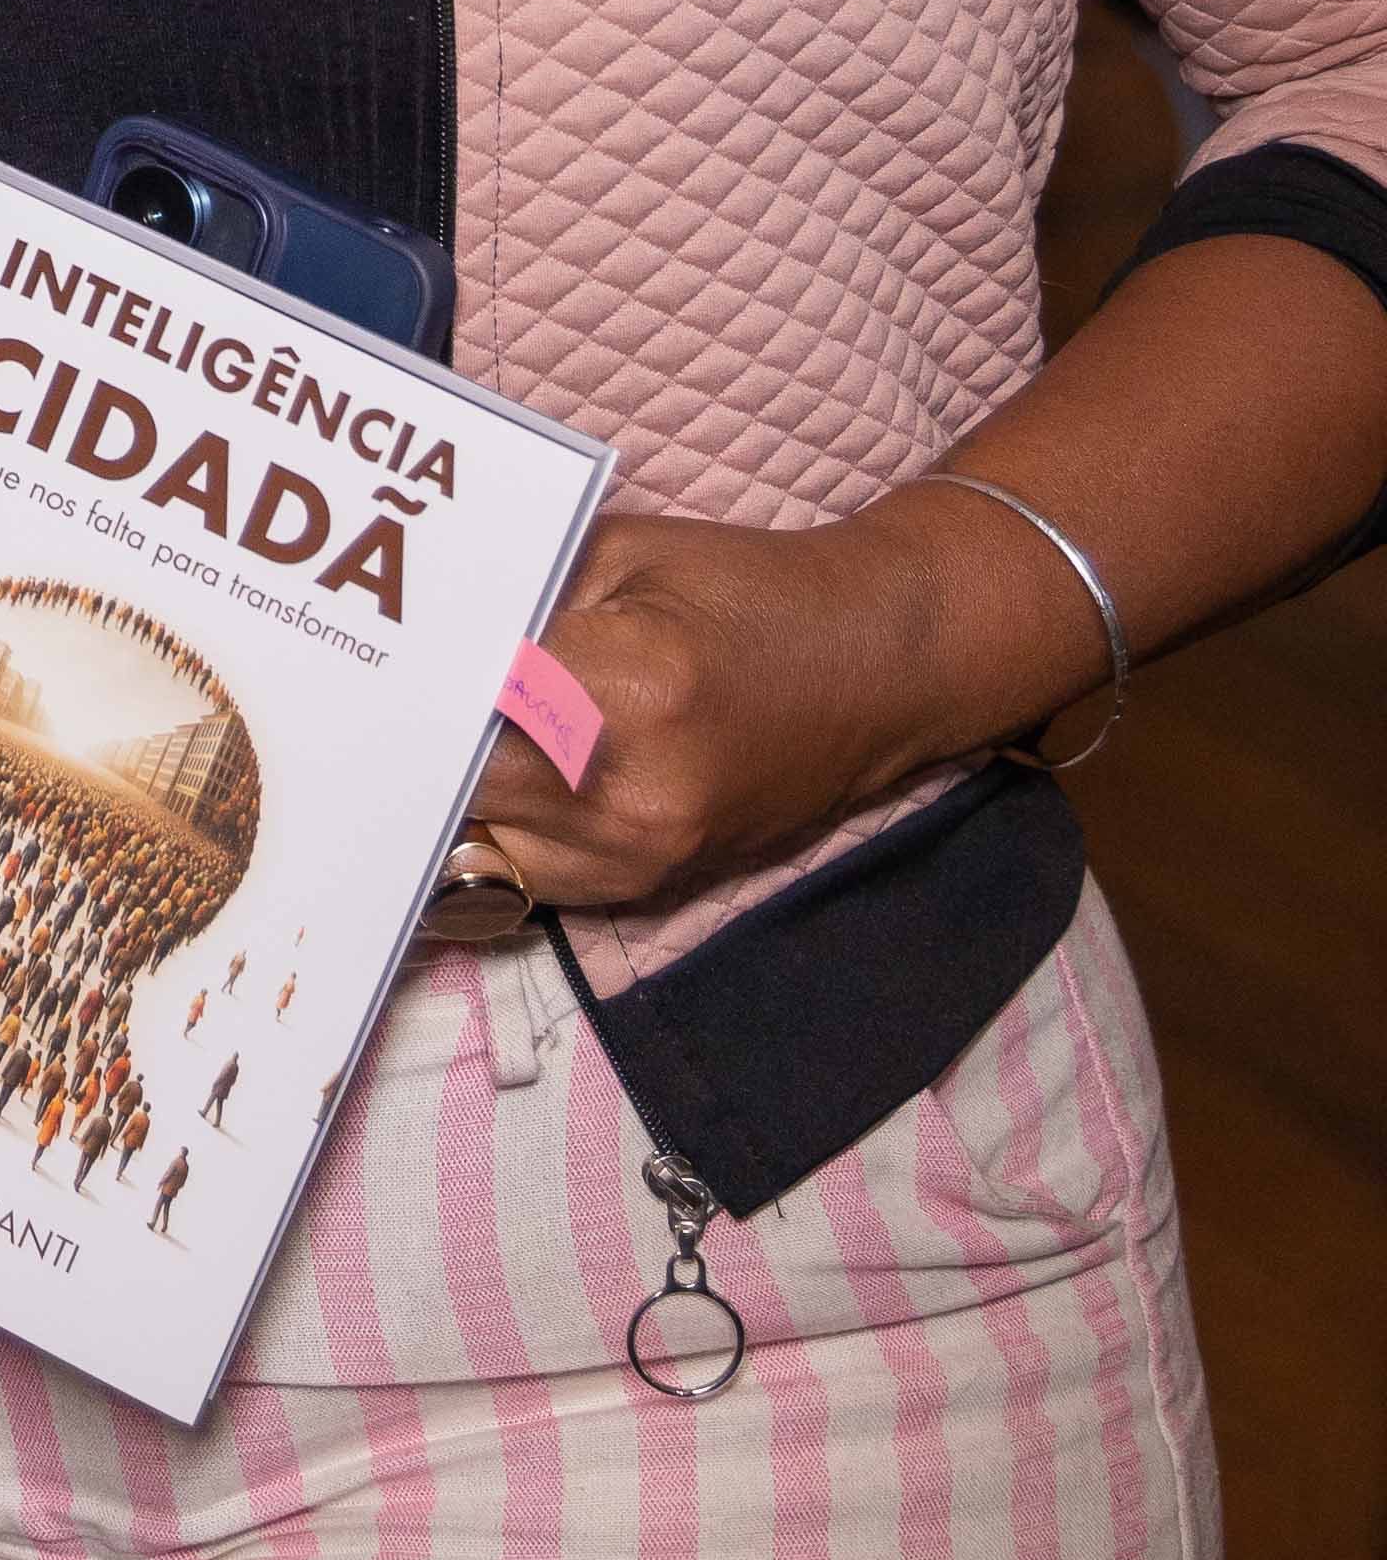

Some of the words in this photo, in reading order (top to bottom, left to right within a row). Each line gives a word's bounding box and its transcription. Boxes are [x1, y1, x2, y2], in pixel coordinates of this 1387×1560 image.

[29, 483, 77, 517] nos
[85, 499, 146, 551] falta
[151, 543, 220, 587] para
[228, 573, 389, 668] transformar
